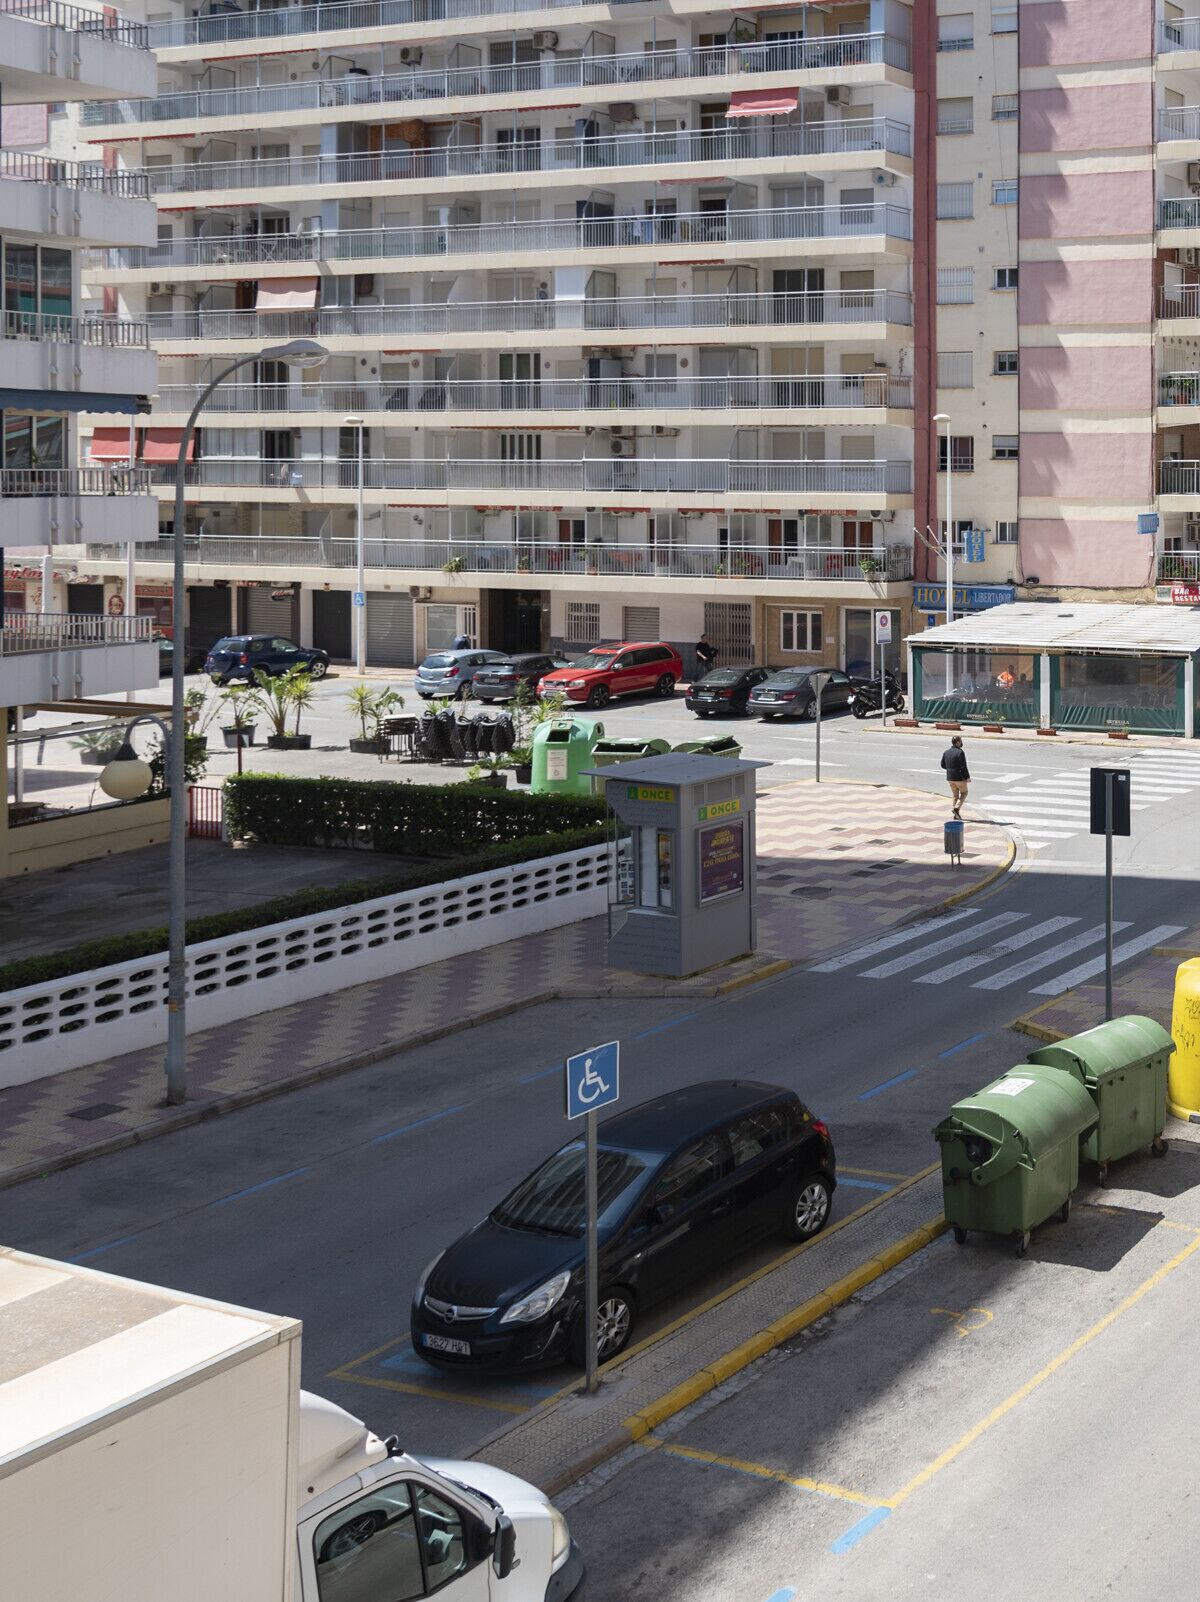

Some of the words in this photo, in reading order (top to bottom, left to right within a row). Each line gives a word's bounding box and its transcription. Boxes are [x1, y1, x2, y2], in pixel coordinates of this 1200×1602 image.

[917, 587, 971, 604] HOTEL
[974, 591, 1011, 603] LIBERTADOR
[641, 789, 671, 800] ONCE
[710, 802, 737, 816] ONCE
[428, 1336, 448, 1348] 3627
